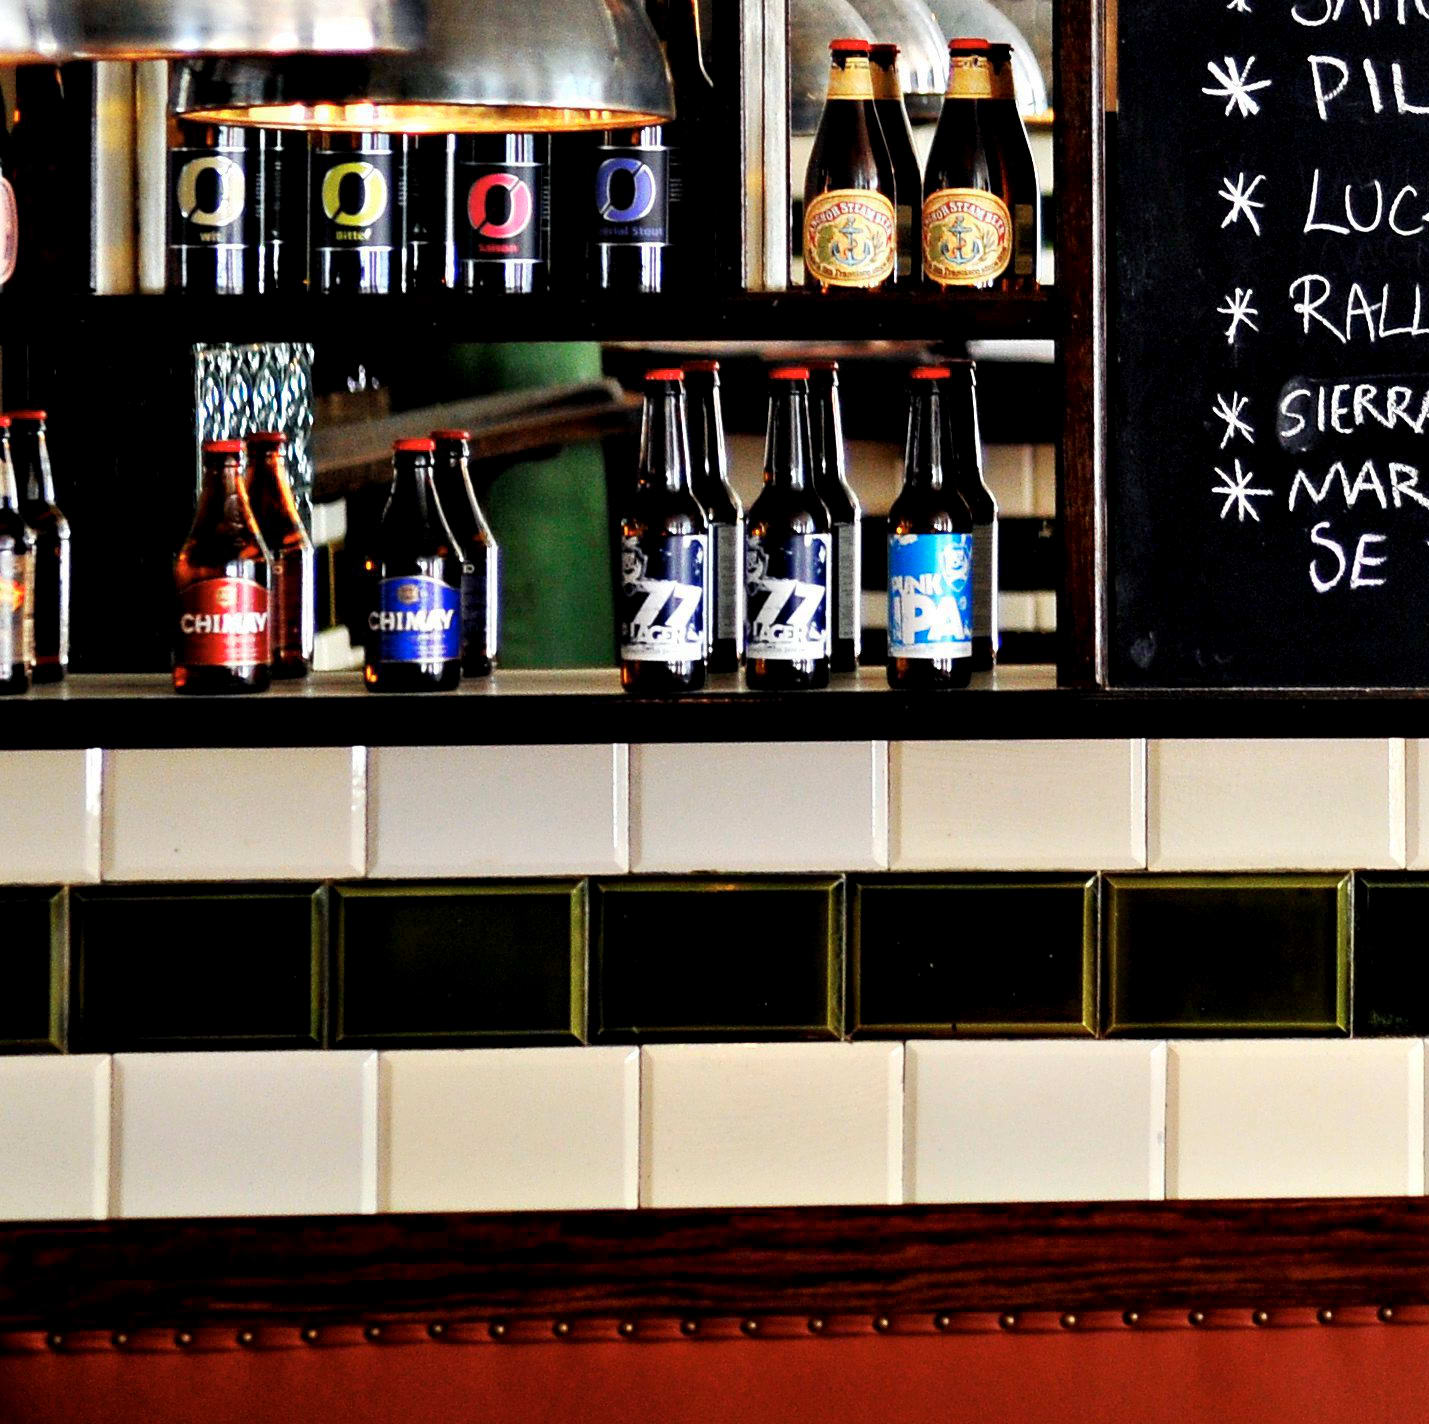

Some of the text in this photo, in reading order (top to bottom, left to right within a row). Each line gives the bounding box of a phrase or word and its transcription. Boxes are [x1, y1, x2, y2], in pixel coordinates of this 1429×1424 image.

[1309, 521, 1387, 593] SE
[180, 612, 268, 635] CHIMAY
[368, 609, 454, 632] CHIMAY
